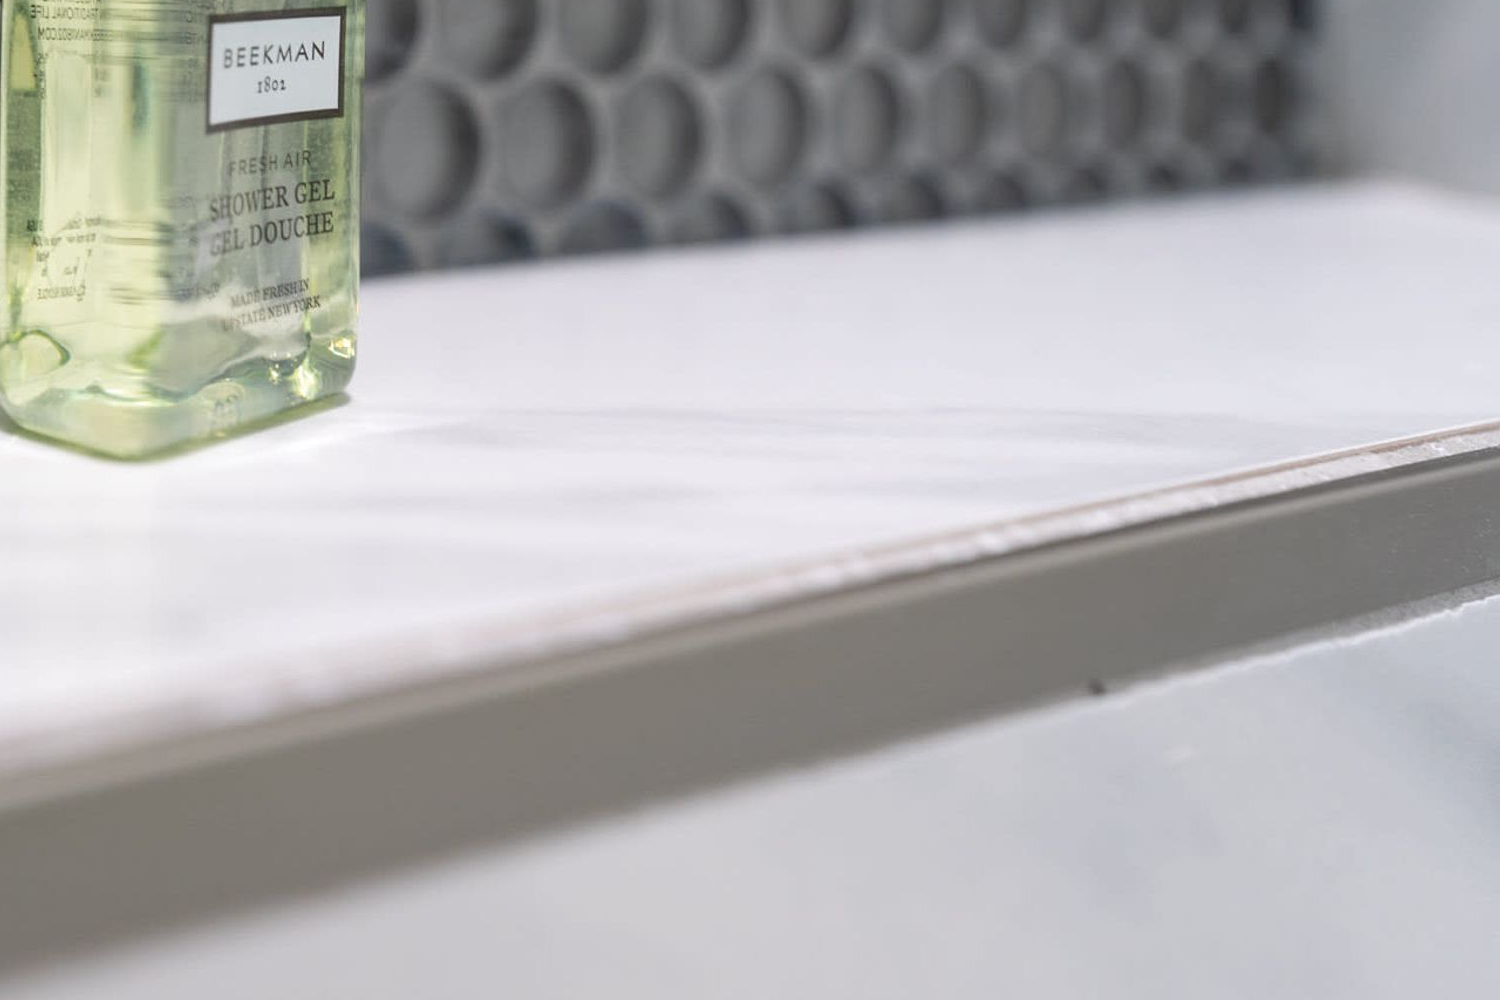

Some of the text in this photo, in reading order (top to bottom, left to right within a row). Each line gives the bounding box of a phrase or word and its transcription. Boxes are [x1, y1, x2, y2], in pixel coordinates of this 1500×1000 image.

[223, 41, 325, 69] BEEKMAN
[257, 75, 287, 94] 1802
[229, 150, 312, 176] FRESH AIR
[209, 179, 335, 223] SHOWER GEL
[210, 211, 334, 257] GEL DOUCHE
[231, 289, 260, 309] MADE
[263, 281, 298, 301] FRESH
[299, 278, 310, 293] IN
[268, 301, 293, 319] NEW
[293, 295, 321, 315] YORK
